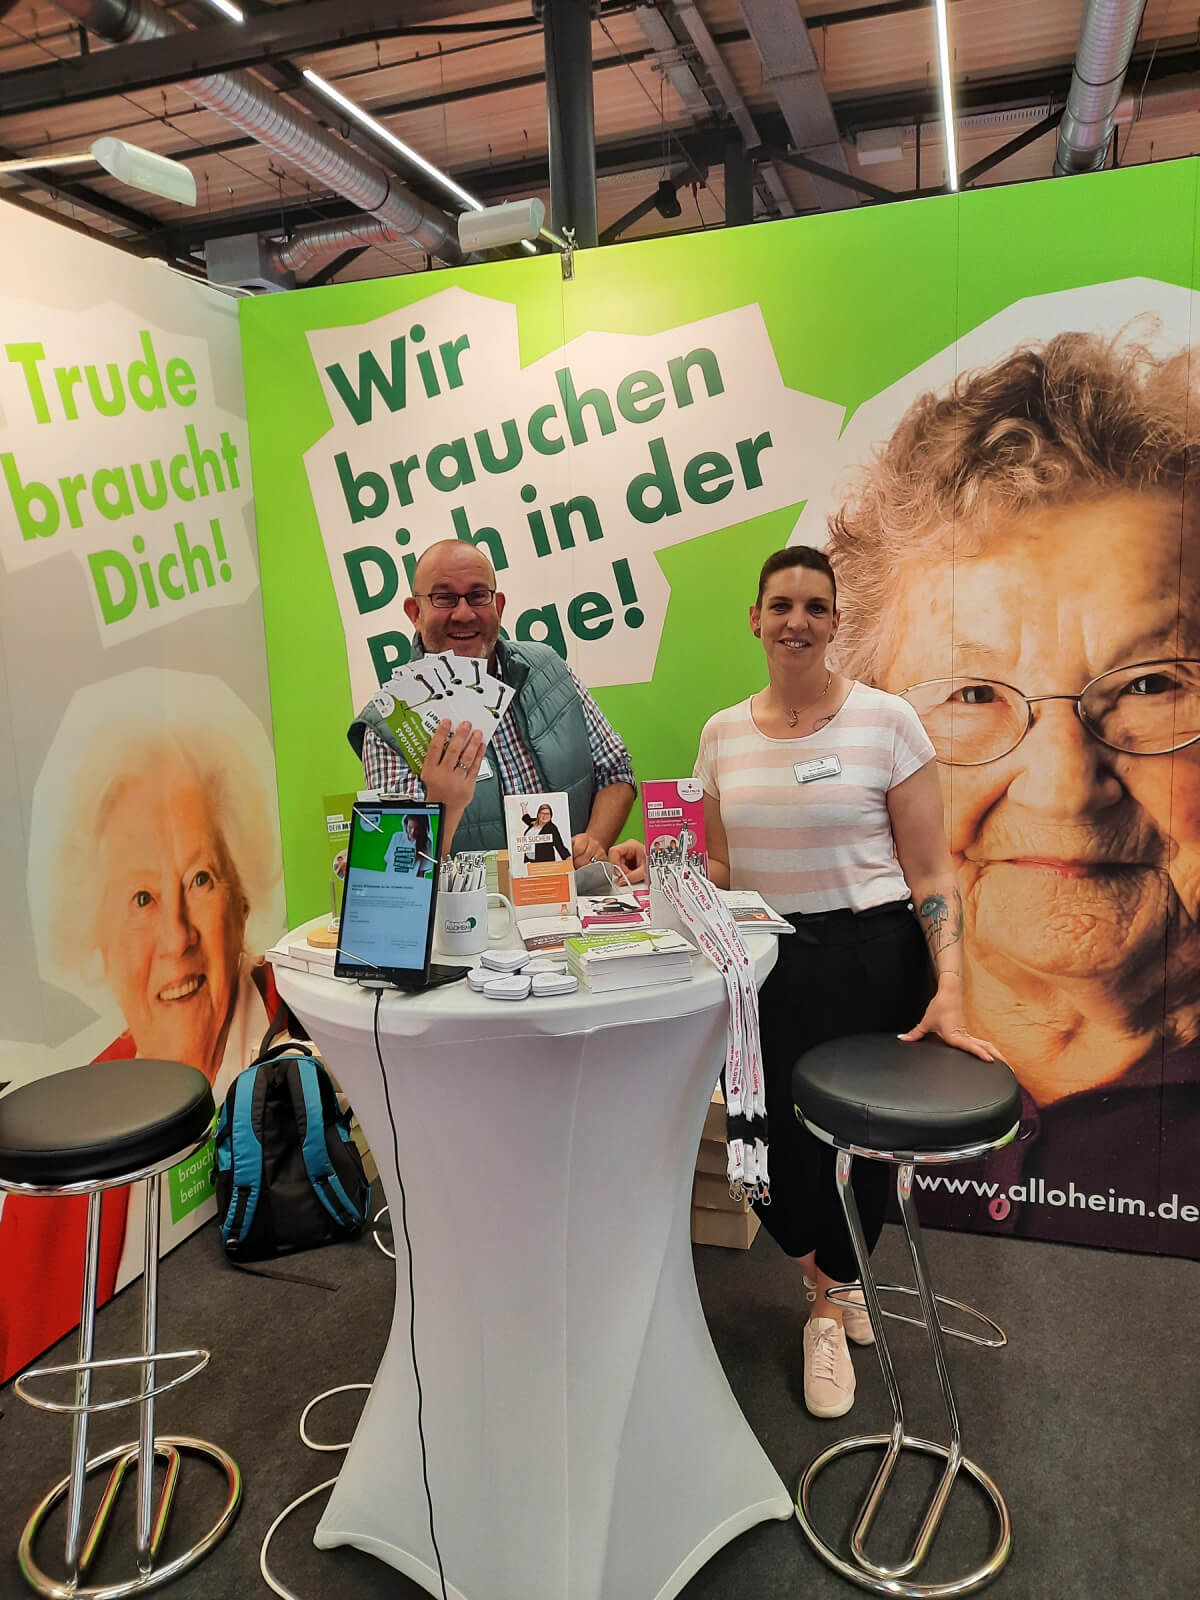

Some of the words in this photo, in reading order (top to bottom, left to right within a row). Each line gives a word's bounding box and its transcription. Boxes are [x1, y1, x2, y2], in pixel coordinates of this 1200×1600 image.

[5, 330, 198, 424] Trude
[325, 323, 470, 426] Wir
[0, 423, 241, 541] braucht
[334, 347, 725, 524] brauchen
[87, 518, 232, 626] Dich!
[343, 505, 509, 615] Dih
[520, 484, 604, 558] in
[625, 431, 773, 524] der
[366, 557, 645, 690] Pge!
[690, 877, 700, 892] PRO
[697, 890, 712, 911] TALIS
[699, 933, 713, 952] TALIS
[711, 951, 724, 967] PRO
[180, 1180, 205, 1204] beim
[915, 1174, 1199, 1223] www.alloheim.de
